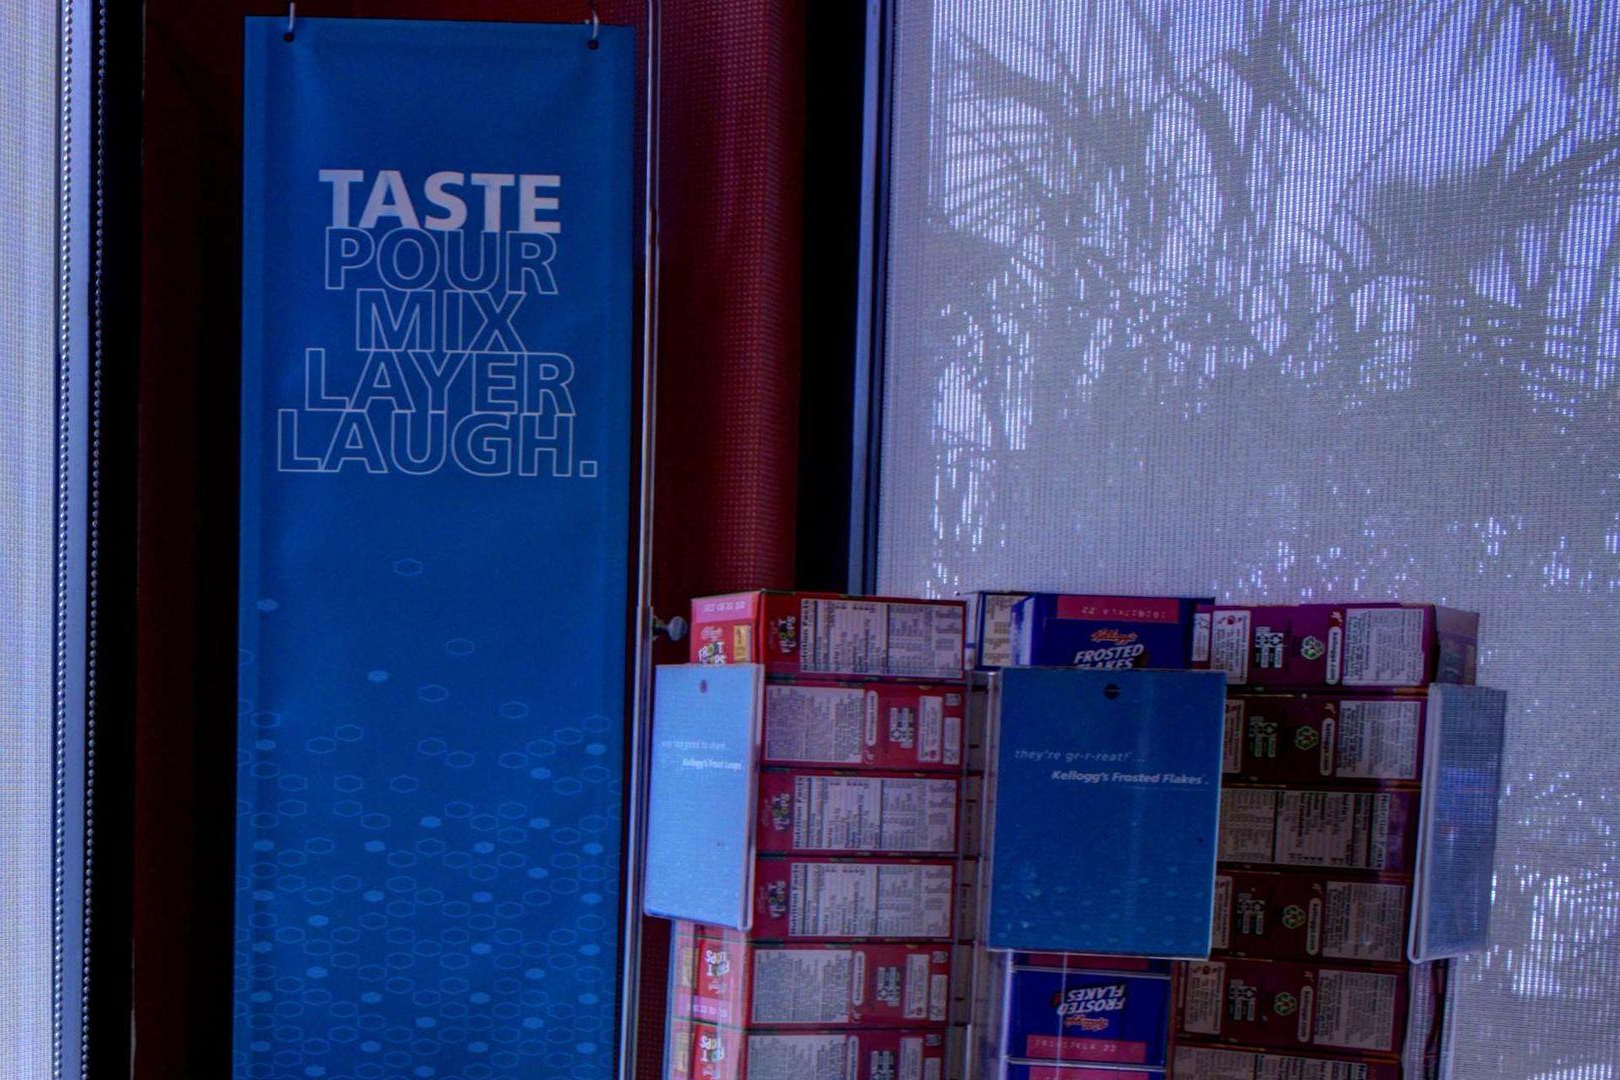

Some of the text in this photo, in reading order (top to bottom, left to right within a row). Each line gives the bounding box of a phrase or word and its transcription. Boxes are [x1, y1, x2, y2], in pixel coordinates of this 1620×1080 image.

[318, 169, 562, 235] TASTE
[324, 226, 559, 295] POUR
[355, 287, 528, 353] MIX
[304, 347, 577, 417] LAYER
[277, 408, 598, 478] LAUGH.
[1073, 643, 1145, 665] FROSTED
[1014, 749, 1062, 763] they're
[1050, 769, 1109, 784] Kellogg's
[1111, 771, 1160, 784] Frosted
[1056, 996, 1126, 1017] FROSTED
[1068, 984, 1126, 1001] FLAKES
